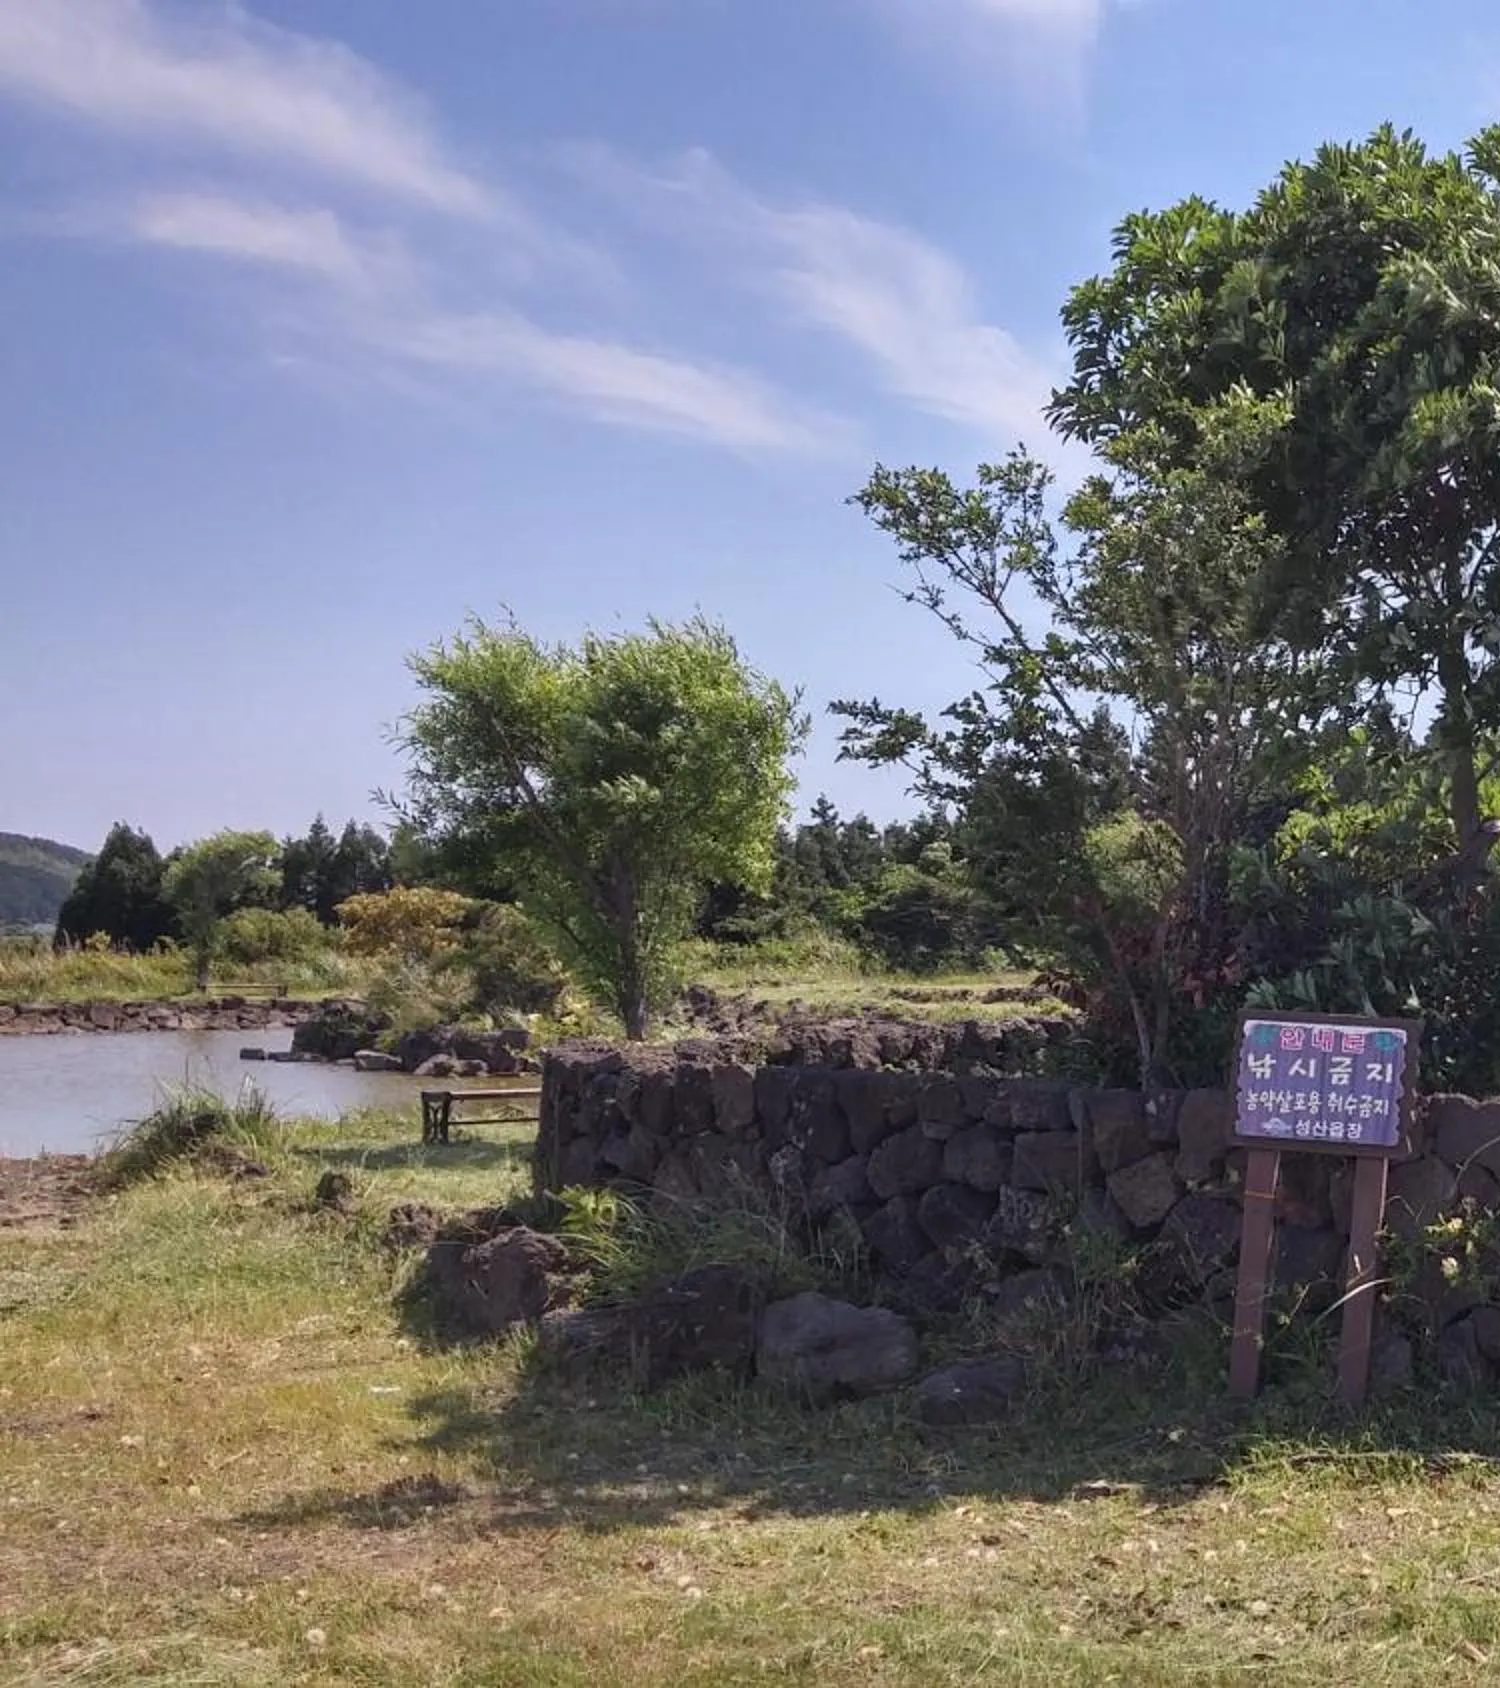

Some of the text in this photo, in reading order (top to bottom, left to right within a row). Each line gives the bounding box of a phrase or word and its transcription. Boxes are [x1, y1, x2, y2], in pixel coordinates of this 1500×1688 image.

[1247, 1053, 1393, 1085] 낚시금지
[1246, 1089, 1389, 1118] 농약살포용 취수금지
[1295, 1119, 1363, 1139] 성산읍장
